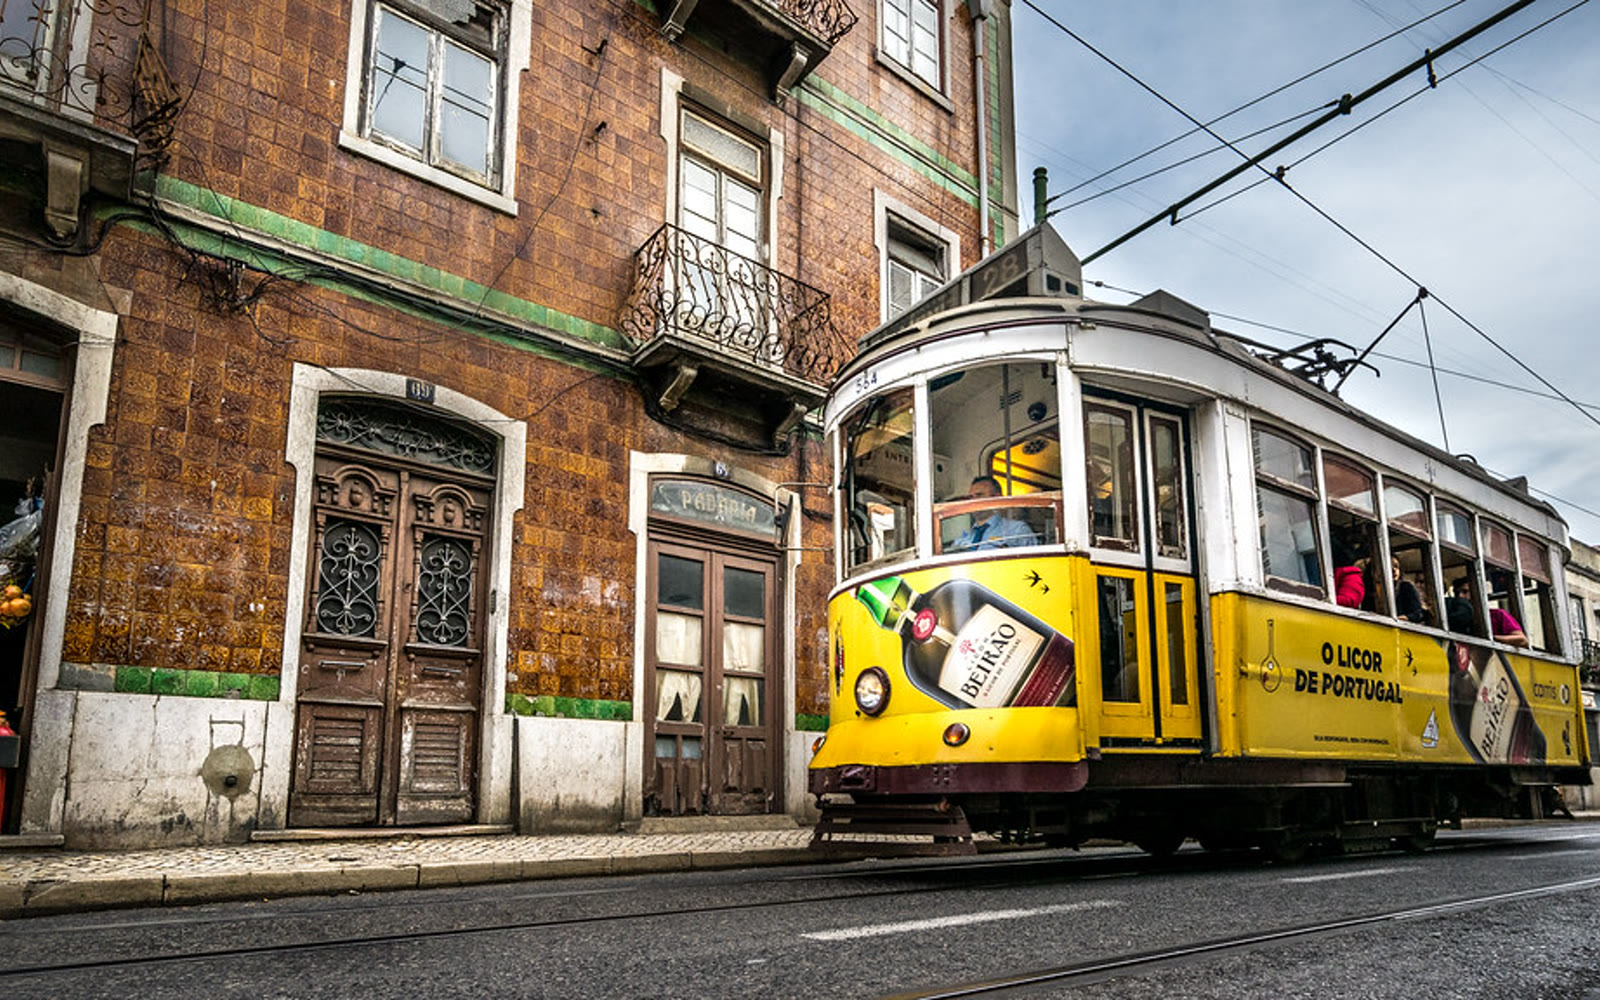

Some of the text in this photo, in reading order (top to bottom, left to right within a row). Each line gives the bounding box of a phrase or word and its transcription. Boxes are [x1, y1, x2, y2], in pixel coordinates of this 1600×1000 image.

[983, 253, 1019, 297] 28
[960, 623, 1016, 699] BEIRÃO
[1321, 642, 1382, 672] O LICOR
[1295, 668, 1403, 704] DE PORTUGAL
